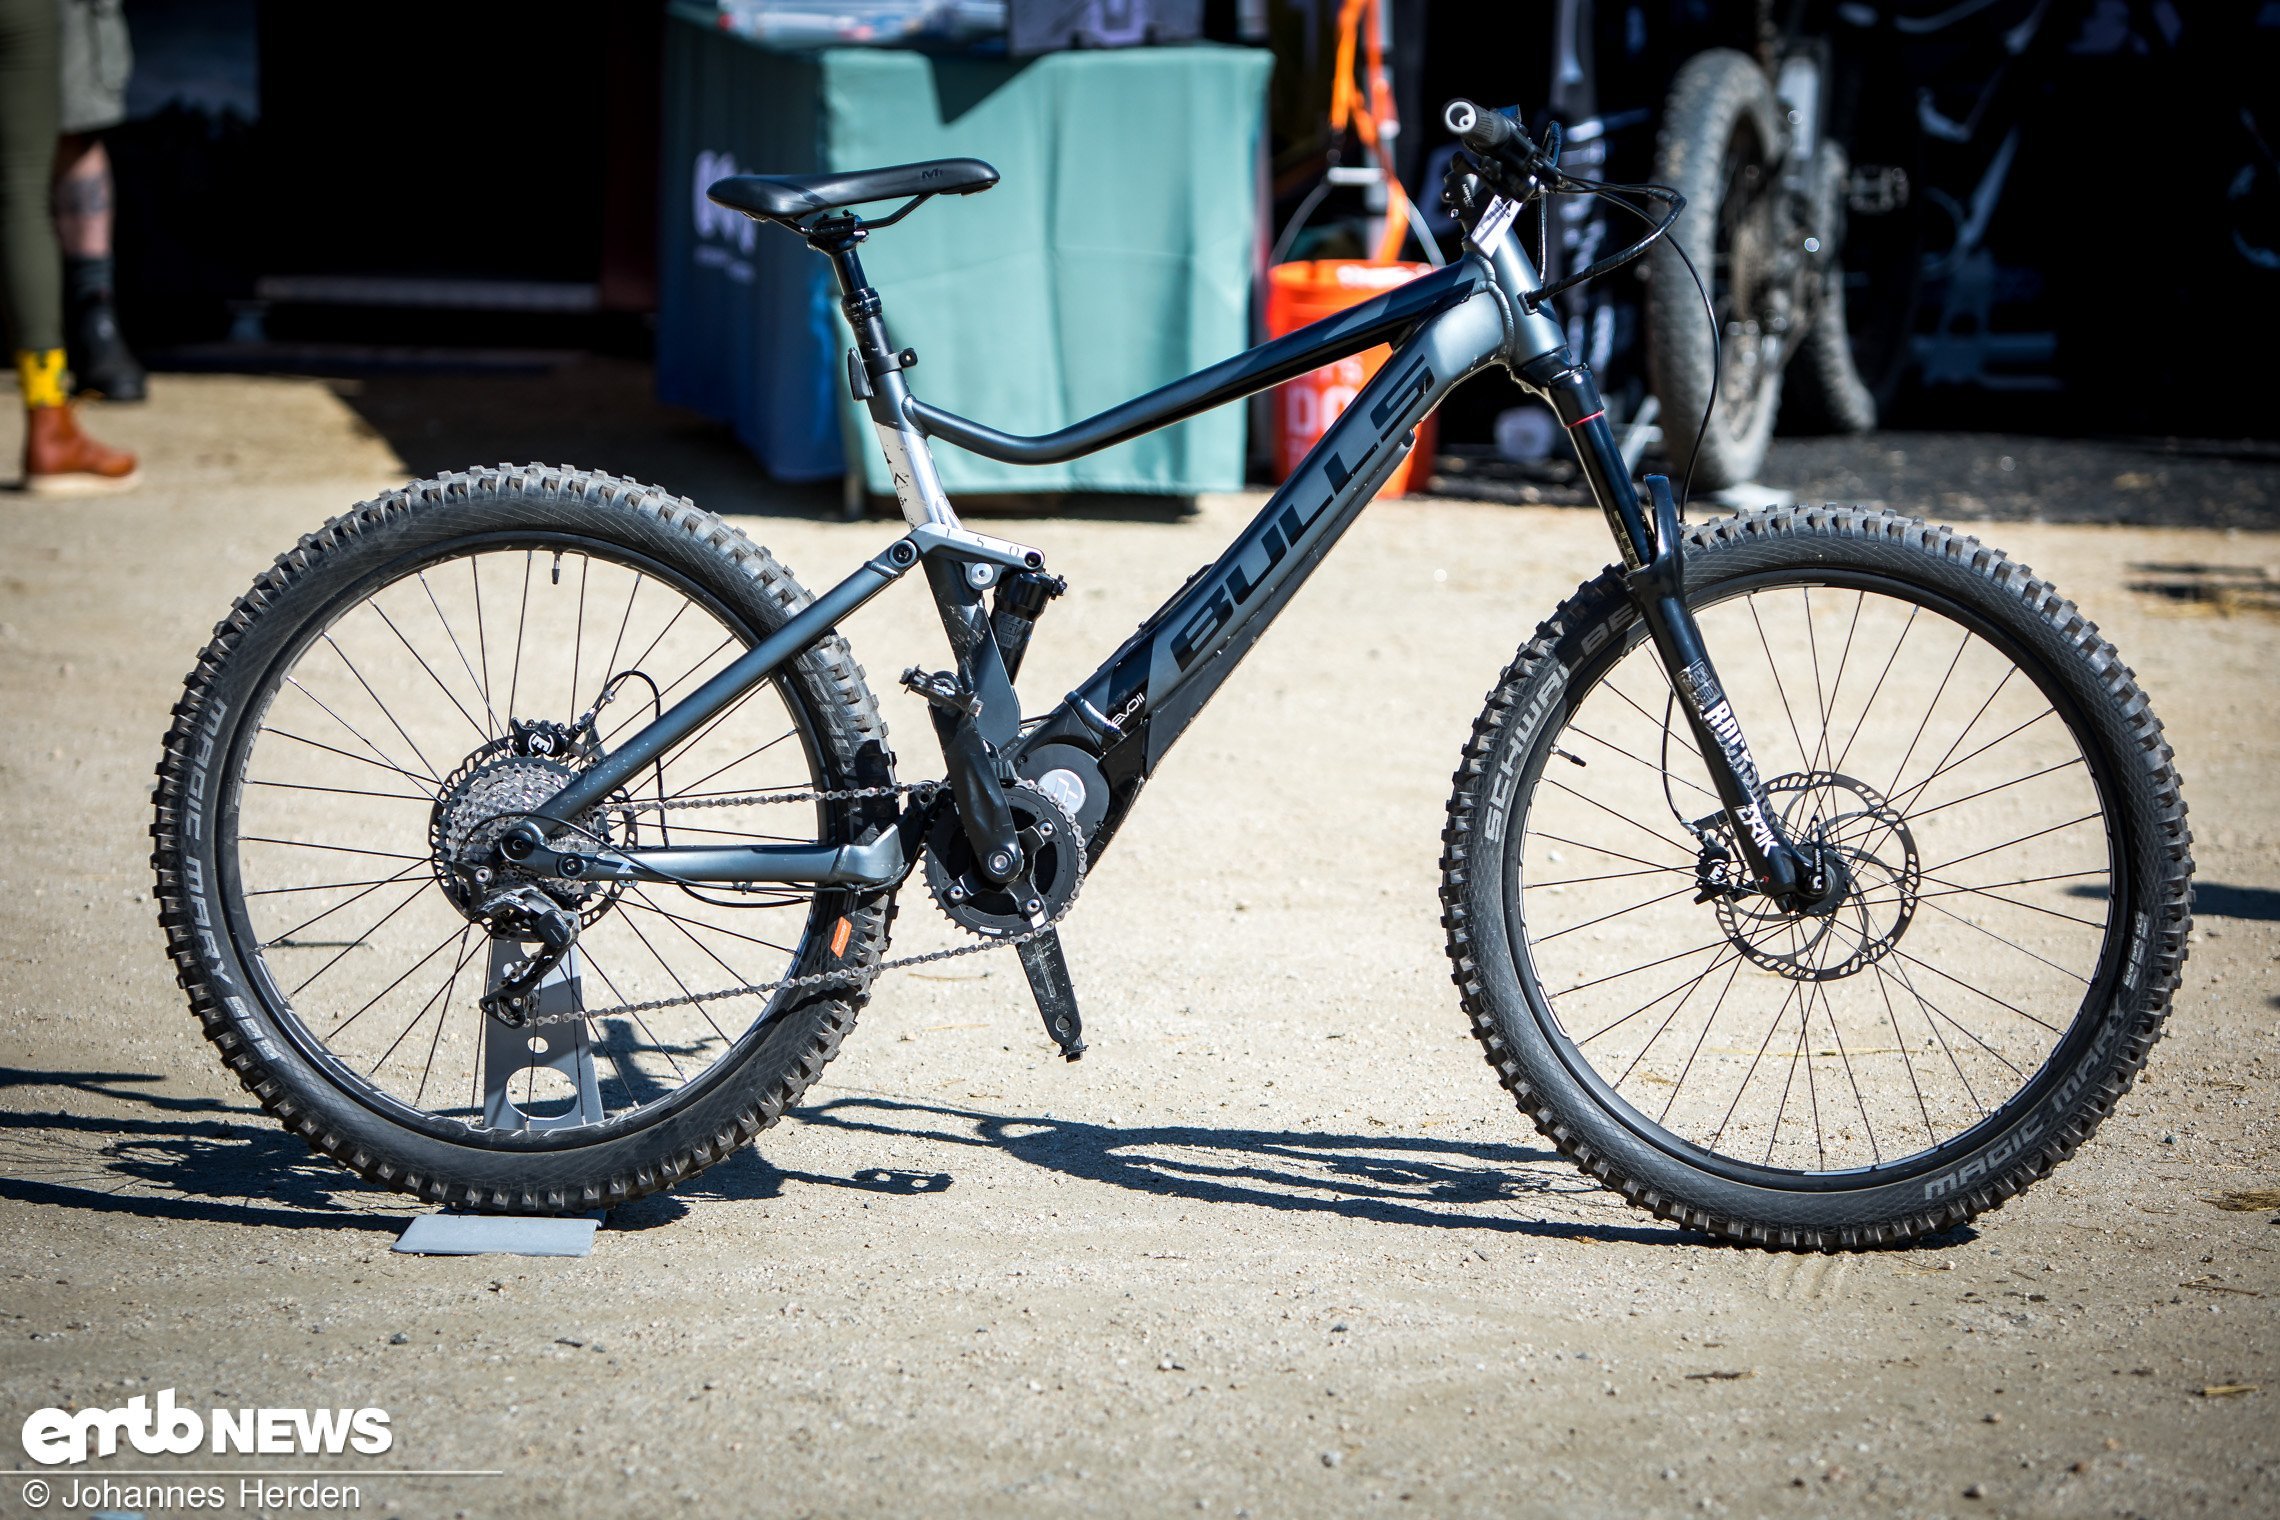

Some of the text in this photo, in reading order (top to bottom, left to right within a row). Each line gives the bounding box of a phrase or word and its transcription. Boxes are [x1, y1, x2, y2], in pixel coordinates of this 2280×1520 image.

[1170, 353, 1435, 672] BULLS
[185, 696, 233, 985] MAGIC MARY
[1484, 602, 1634, 842] SCHWALBE
[1924, 1114, 2044, 1201] MAGIC
